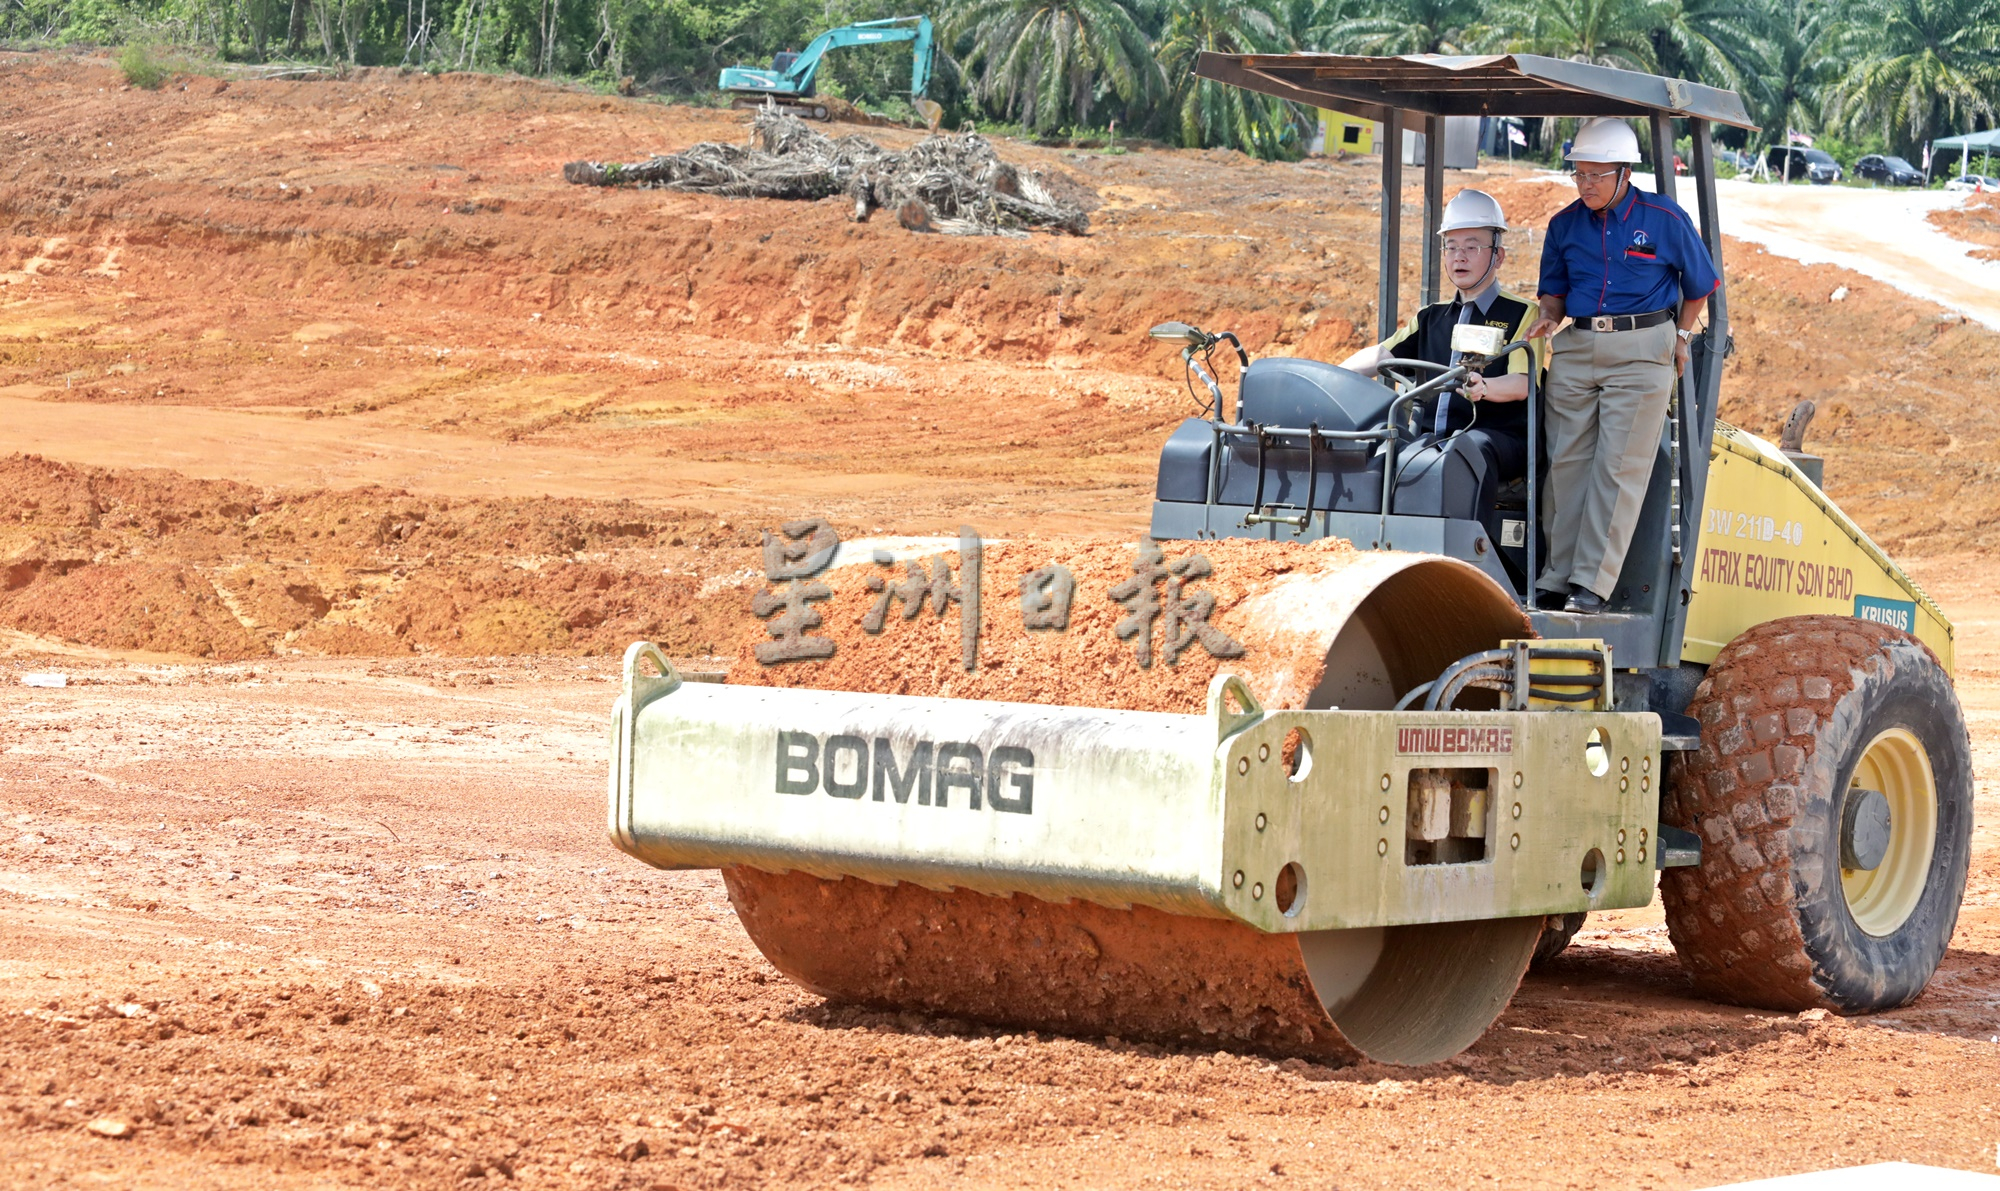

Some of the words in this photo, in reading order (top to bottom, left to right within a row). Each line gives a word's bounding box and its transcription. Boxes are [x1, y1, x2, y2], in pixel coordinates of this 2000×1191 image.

[1744, 554, 1795, 594] EQUITY
[1796, 560, 1825, 598] SDN
[1826, 565, 1854, 601] BHD
[1861, 605, 1908, 631] KRUSUS
[775, 730, 1035, 815] BOMAG
